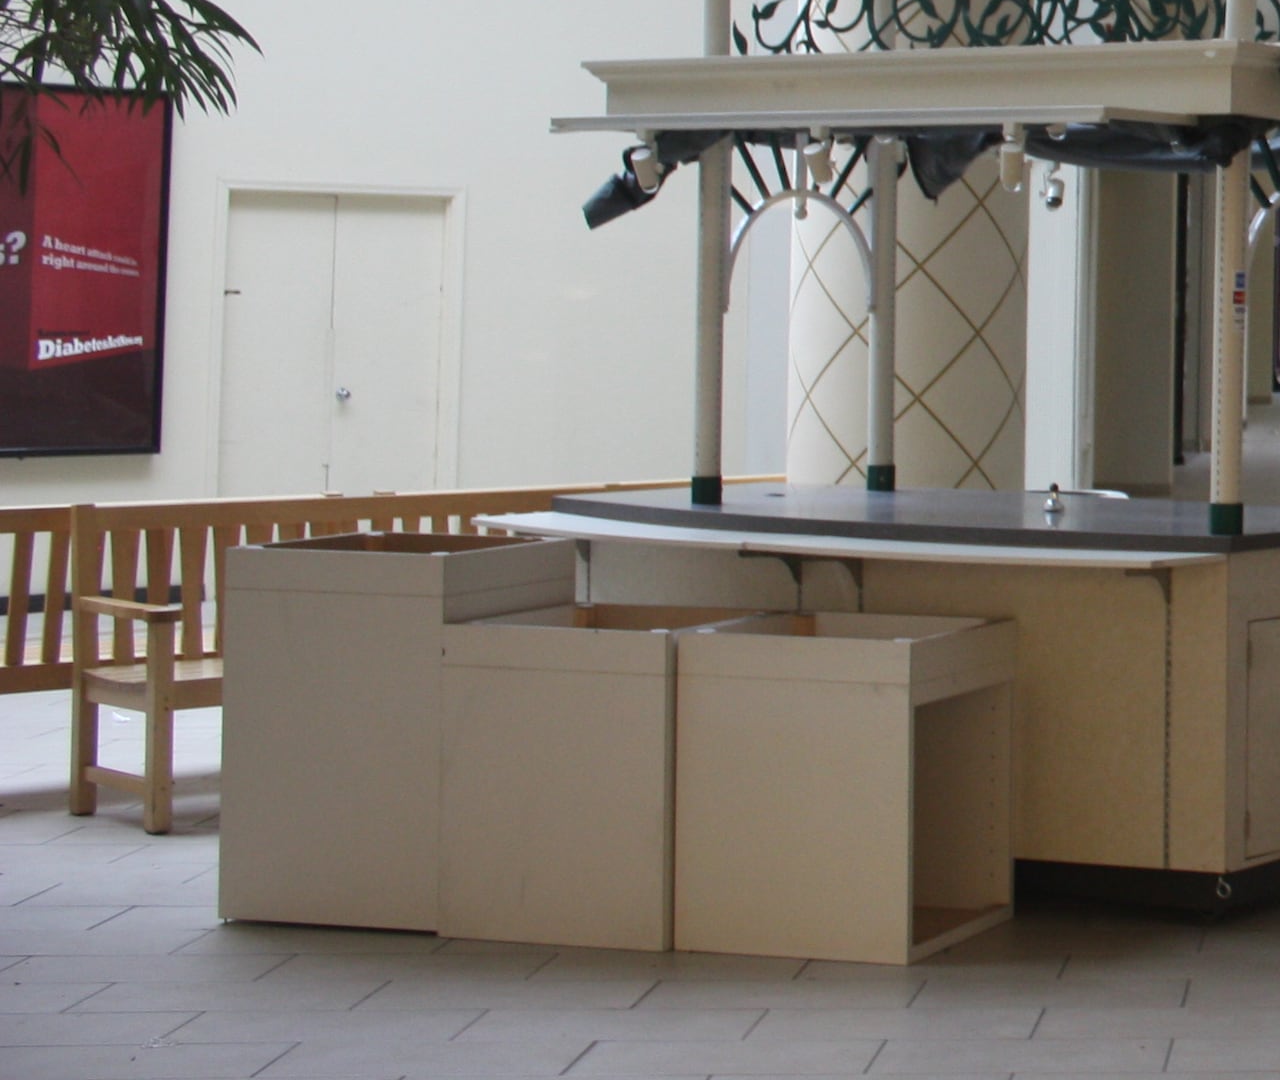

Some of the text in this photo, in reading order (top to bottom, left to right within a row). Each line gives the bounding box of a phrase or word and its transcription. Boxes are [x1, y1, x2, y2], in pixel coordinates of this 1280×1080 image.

[42, 234, 54, 248] A
[54, 237, 86, 255] heart
[42, 254, 74, 269] right
